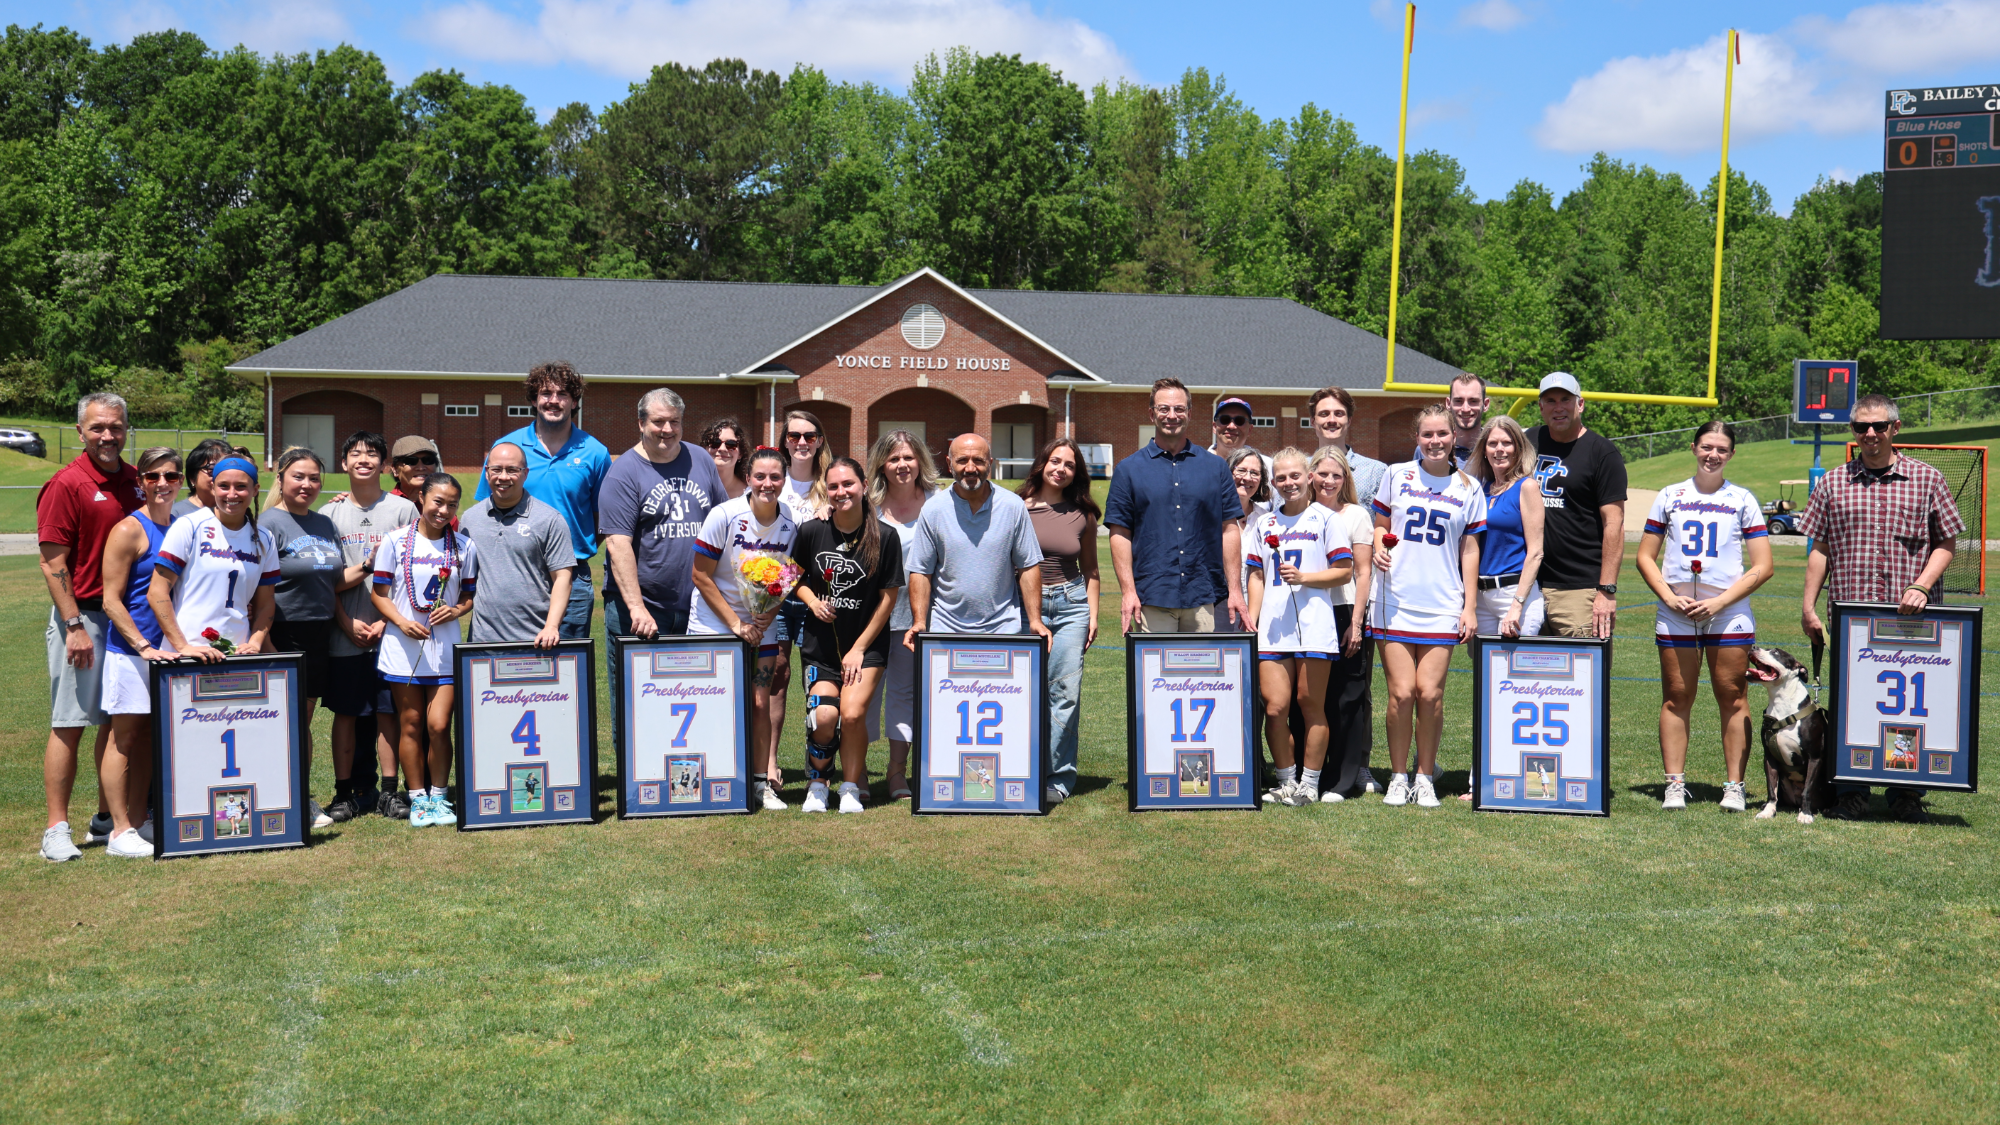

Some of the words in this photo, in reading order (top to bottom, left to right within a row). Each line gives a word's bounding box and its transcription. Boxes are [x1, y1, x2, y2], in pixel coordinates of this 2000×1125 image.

[1890, 91, 1917, 115] PC
[1923, 86, 1987, 101] BAILEY
[1896, 121, 1925, 132] Blue
[1928, 119, 1961, 131] Hose
[1899, 141, 1917, 165] 0
[1946, 154, 1953, 163] 3
[1959, 142, 1987, 151] SHOTS
[1969, 153, 1978, 164] 0
[836, 355, 892, 369] YONCE
[900, 357, 949, 370] FIELD
[955, 358, 1011, 371] HOUSE
[643, 477, 710, 515] GEORGETOWN
[671, 492, 684, 521] 3
[1400, 483, 1463, 507] Presbyterian
[1672, 499, 1736, 515] Presbyterian
[517, 523, 531, 537] PC
[654, 522, 702, 539] IVERSON
[1403, 505, 1451, 546] 25
[1682, 520, 1719, 558] 31
[1271, 549, 1302, 586] 17
[225, 569, 239, 608] 1
[423, 574, 446, 606] 4
[1858, 648, 1952, 668] Presbyterian
[481, 689, 569, 707] Presbyterian
[642, 682, 726, 700] Presbyterian
[939, 679, 1023, 698] Presbyterian
[1152, 678, 1234, 695] Presbyterian
[1499, 681, 1584, 699] Presbyterian
[1876, 670, 1928, 717] 31
[181, 706, 279, 726] Presbyterian
[671, 703, 697, 748] 7
[956, 700, 1003, 745] 12
[1170, 698, 1215, 742] 17
[1512, 701, 1569, 747] 25
[511, 710, 541, 756] 4
[221, 729, 241, 778] 1
